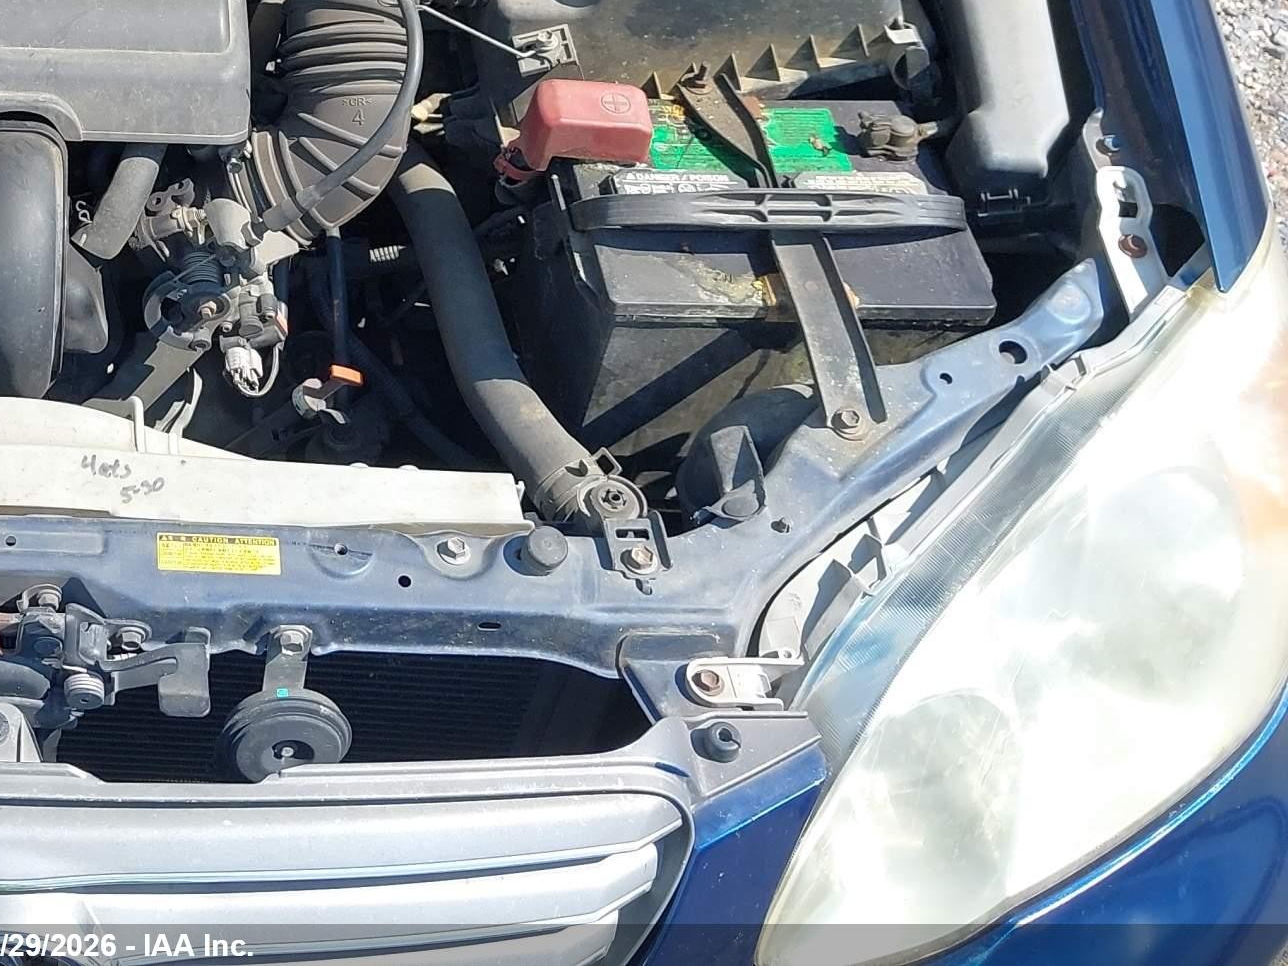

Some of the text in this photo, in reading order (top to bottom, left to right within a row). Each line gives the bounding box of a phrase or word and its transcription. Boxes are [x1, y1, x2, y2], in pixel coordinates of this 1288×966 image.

[351, 109, 366, 127] 4
[192, 536, 229, 544] CAUTION
[234, 538, 276, 546] ATTENTION
